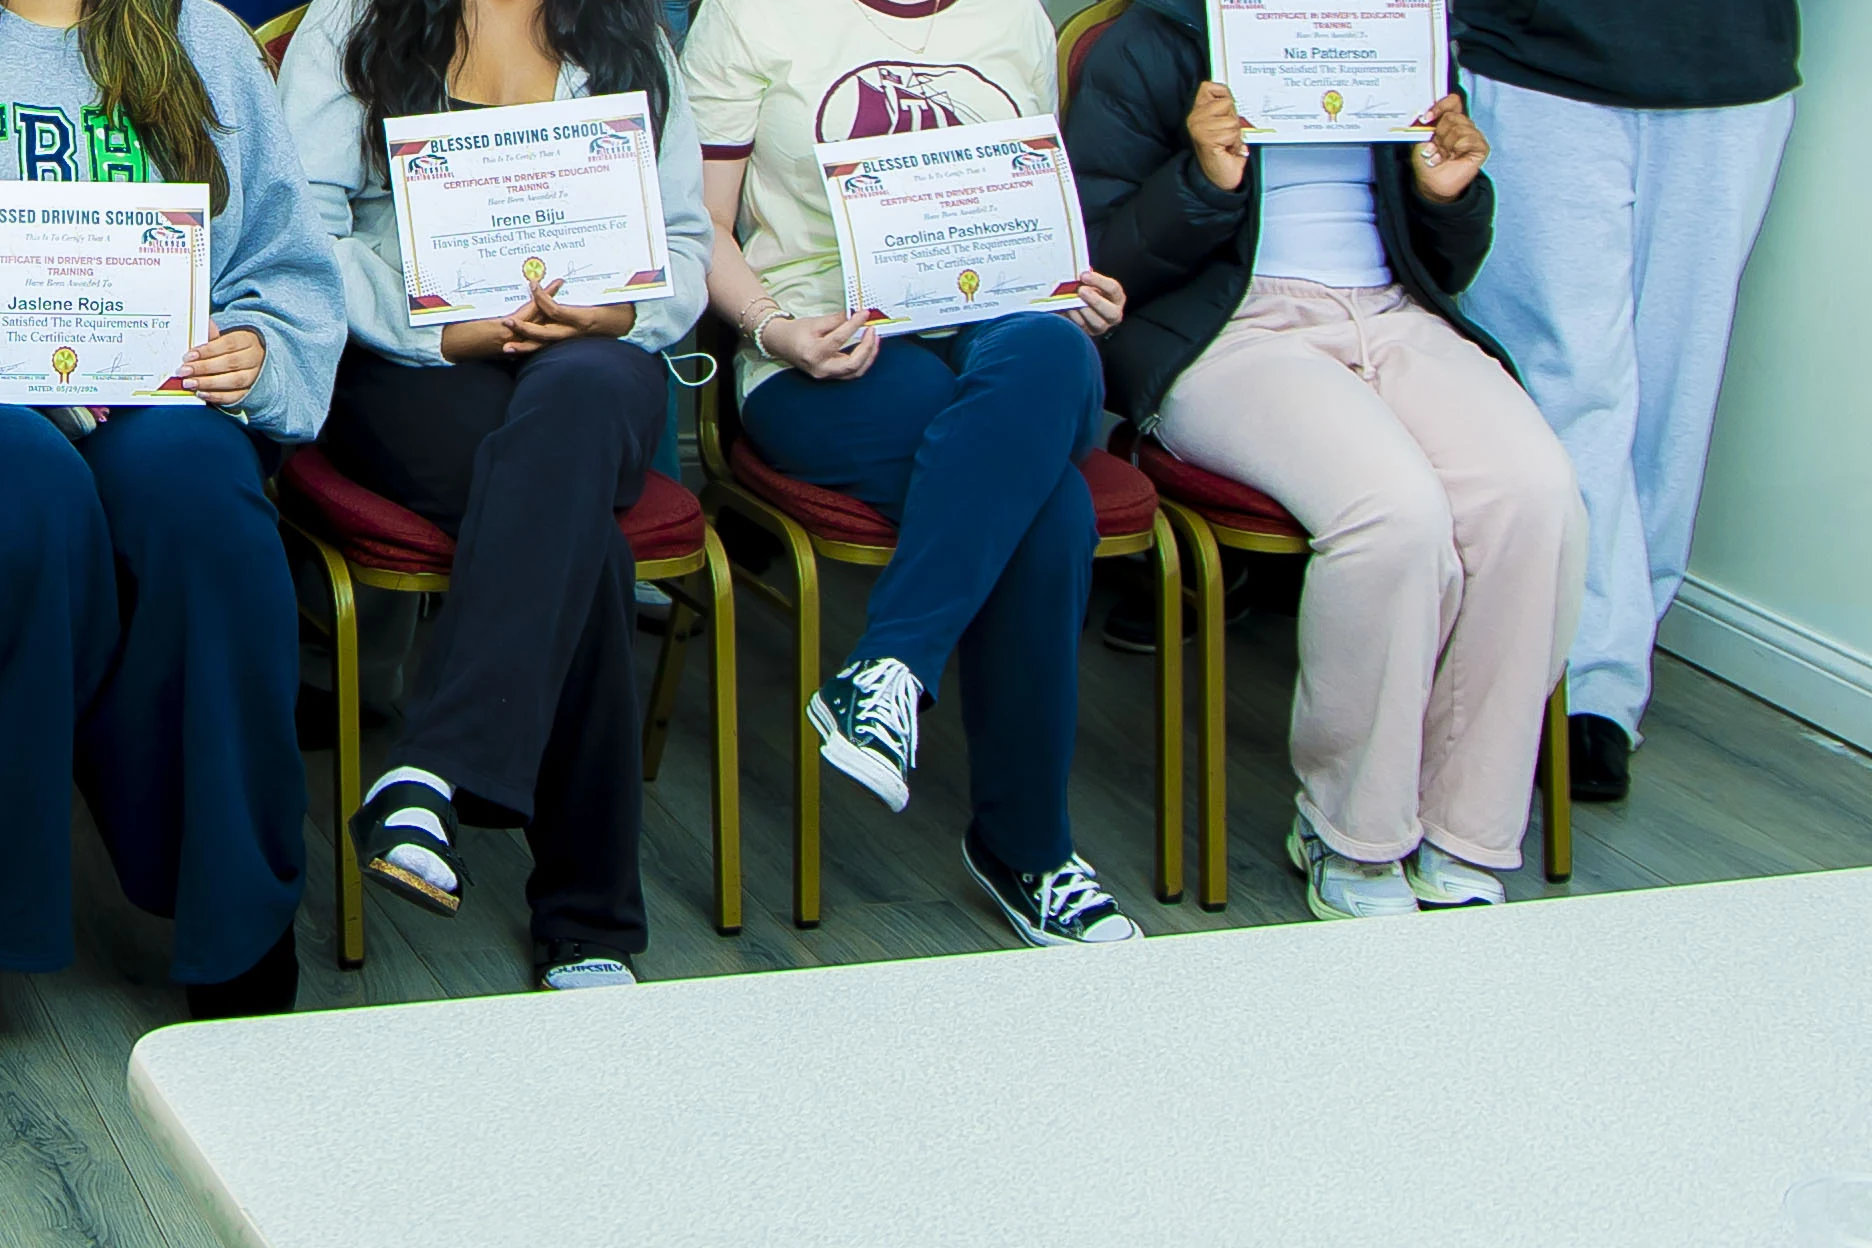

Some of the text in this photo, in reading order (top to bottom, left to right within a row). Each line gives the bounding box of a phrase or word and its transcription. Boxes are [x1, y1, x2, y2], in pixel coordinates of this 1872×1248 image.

[1284, 47, 1377, 59] Nia Patterson
[430, 122, 608, 153] BLESSED DRIVING SCHOOL
[862, 141, 1027, 174] BLESSED DRIVING SCHOOL
[444, 176, 500, 190] CERTIFICATE
[503, 174, 512, 183] IN
[559, 164, 610, 178] EDUCATION
[506, 182, 549, 194] TRAINING
[42, 210, 100, 225] DRIVING
[105, 210, 164, 226] SCHOOL
[492, 209, 565, 228] Irene Biju
[433, 218, 627, 250] Having Satisfied The Requirements For
[885, 230, 945, 248] Carolina
[478, 238, 586, 260] The Certificate Award
[44, 256, 54, 265] IN
[57, 256, 102, 266] DRIVER'S
[106, 257, 161, 266] EDUCATION
[47, 268, 94, 276] TRAINING
[8, 296, 124, 315] Jaslene Rojas
[2, 316, 48, 328] Satisfied
[50, 317, 72, 328] The
[75, 317, 148, 331] Requirements
[152, 318, 170, 328] For
[6, 331, 123, 343] The Certificate Award
